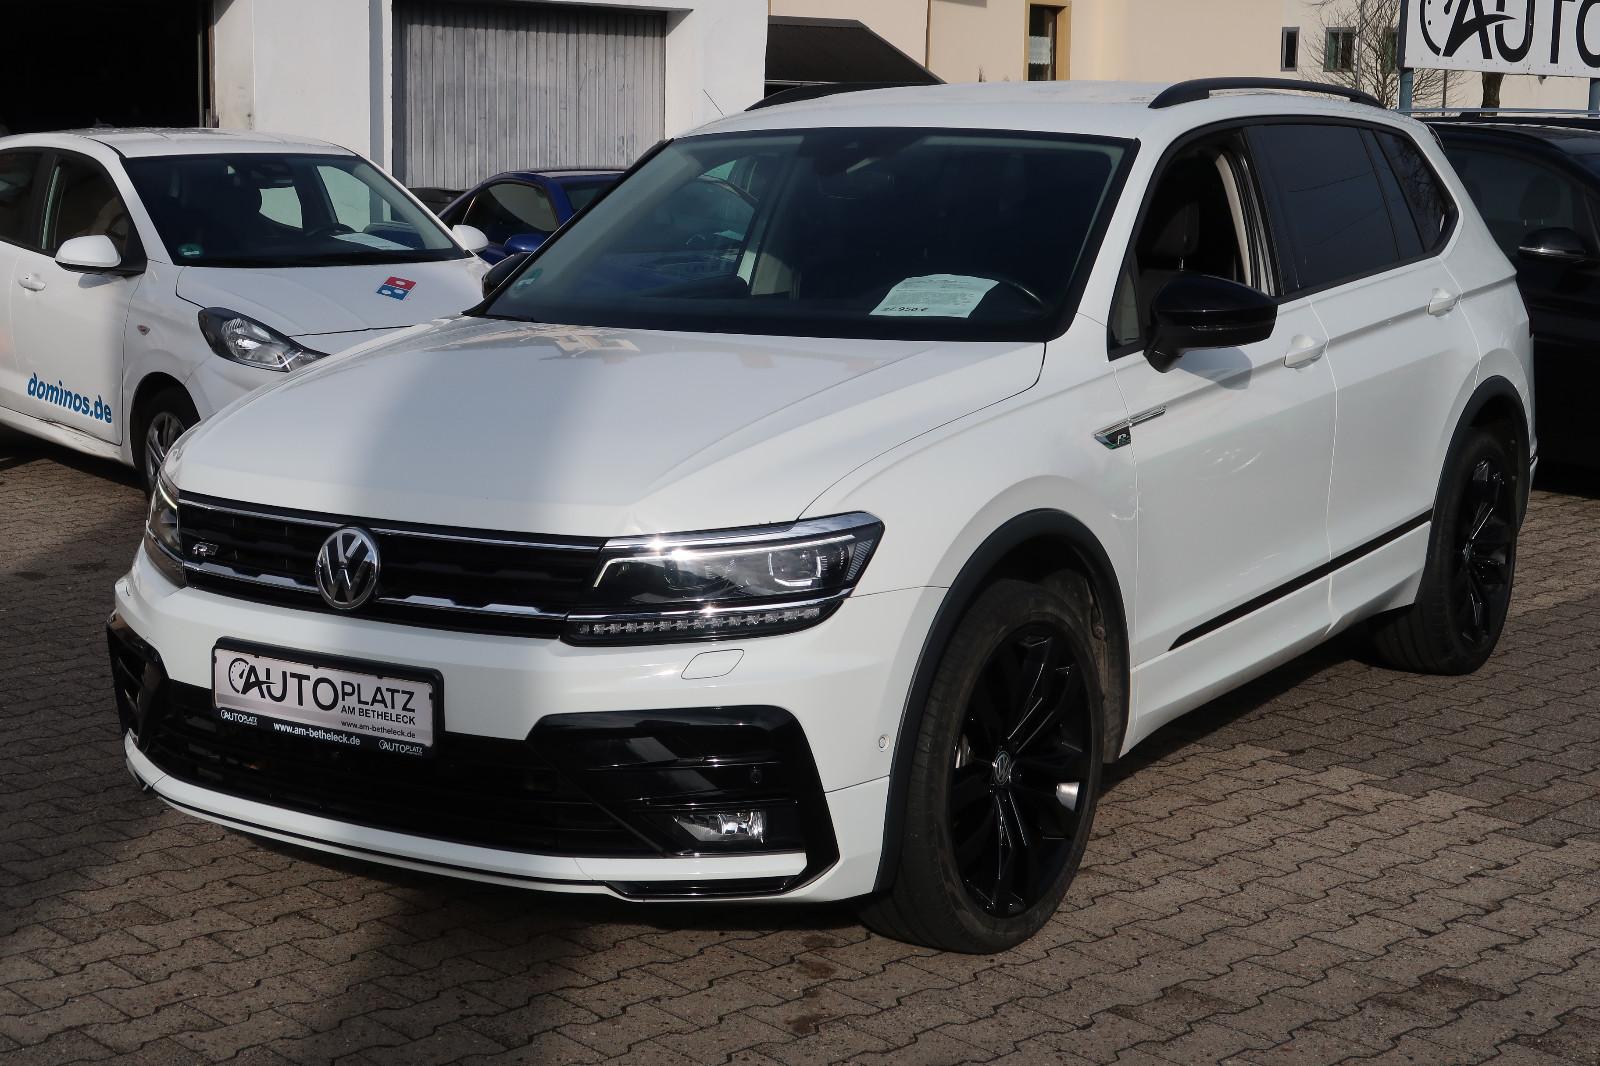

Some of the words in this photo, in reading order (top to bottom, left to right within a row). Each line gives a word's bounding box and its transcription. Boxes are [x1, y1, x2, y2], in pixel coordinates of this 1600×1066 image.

[27, 372, 112, 423] dominos.de
[340, 704, 356, 716] AM
[358, 707, 416, 726] BETHELECK
[273, 722, 361, 746] www.am-betheleck.de
[340, 720, 416, 739] www.am-betheleck.de
